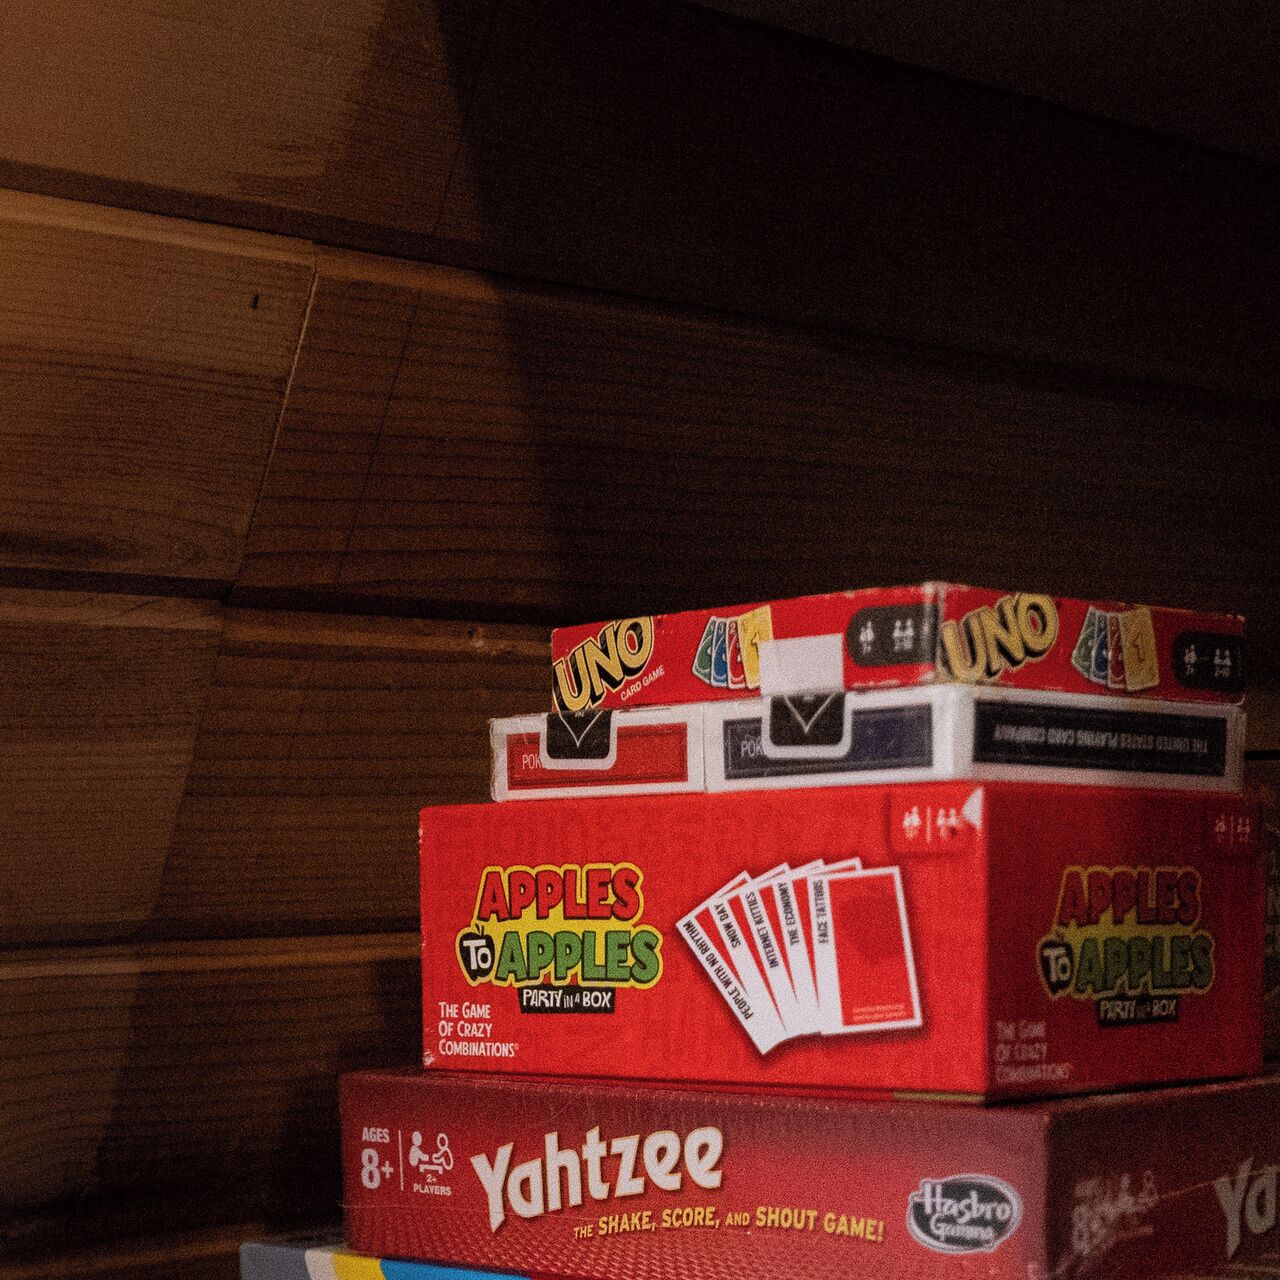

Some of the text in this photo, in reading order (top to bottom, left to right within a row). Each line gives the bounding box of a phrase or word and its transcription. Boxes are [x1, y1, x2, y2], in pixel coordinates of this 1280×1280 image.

[939, 593, 1059, 683] UNO
[554, 616, 653, 712] UNO
[620, 665, 665, 701] CARD GAME
[1048, 727, 1075, 746] CARD
[1077, 729, 1118, 749] PLAYING
[477, 868, 642, 922] APPLES
[777, 881, 800, 946] THE ECONOMY
[1059, 868, 1200, 928] APPLES
[714, 902, 740, 949] SNOW DAY
[745, 891, 779, 968] INTERNET KITTIES
[495, 930, 661, 985] APPLES
[683, 920, 754, 1020] PEOPLE WITH NO RHYTHM
[1075, 934, 1214, 993] APPLES
[438, 1001, 491, 1019] THE GAME
[523, 988, 563, 1008] PARTY
[583, 990, 613, 1009] BOX
[457, 1020, 493, 1038] CRAZY
[362, 1126, 390, 1144] AGES
[361, 1147, 394, 1190] 8+
[412, 1184, 452, 1197] PLAYERS
[470, 1125, 724, 1233] Yahtzee
[573, 1205, 885, 1242] THE SHAKE, SCORE, AND SHOUT GAME!
[913, 1181, 1012, 1225] Hasbro
